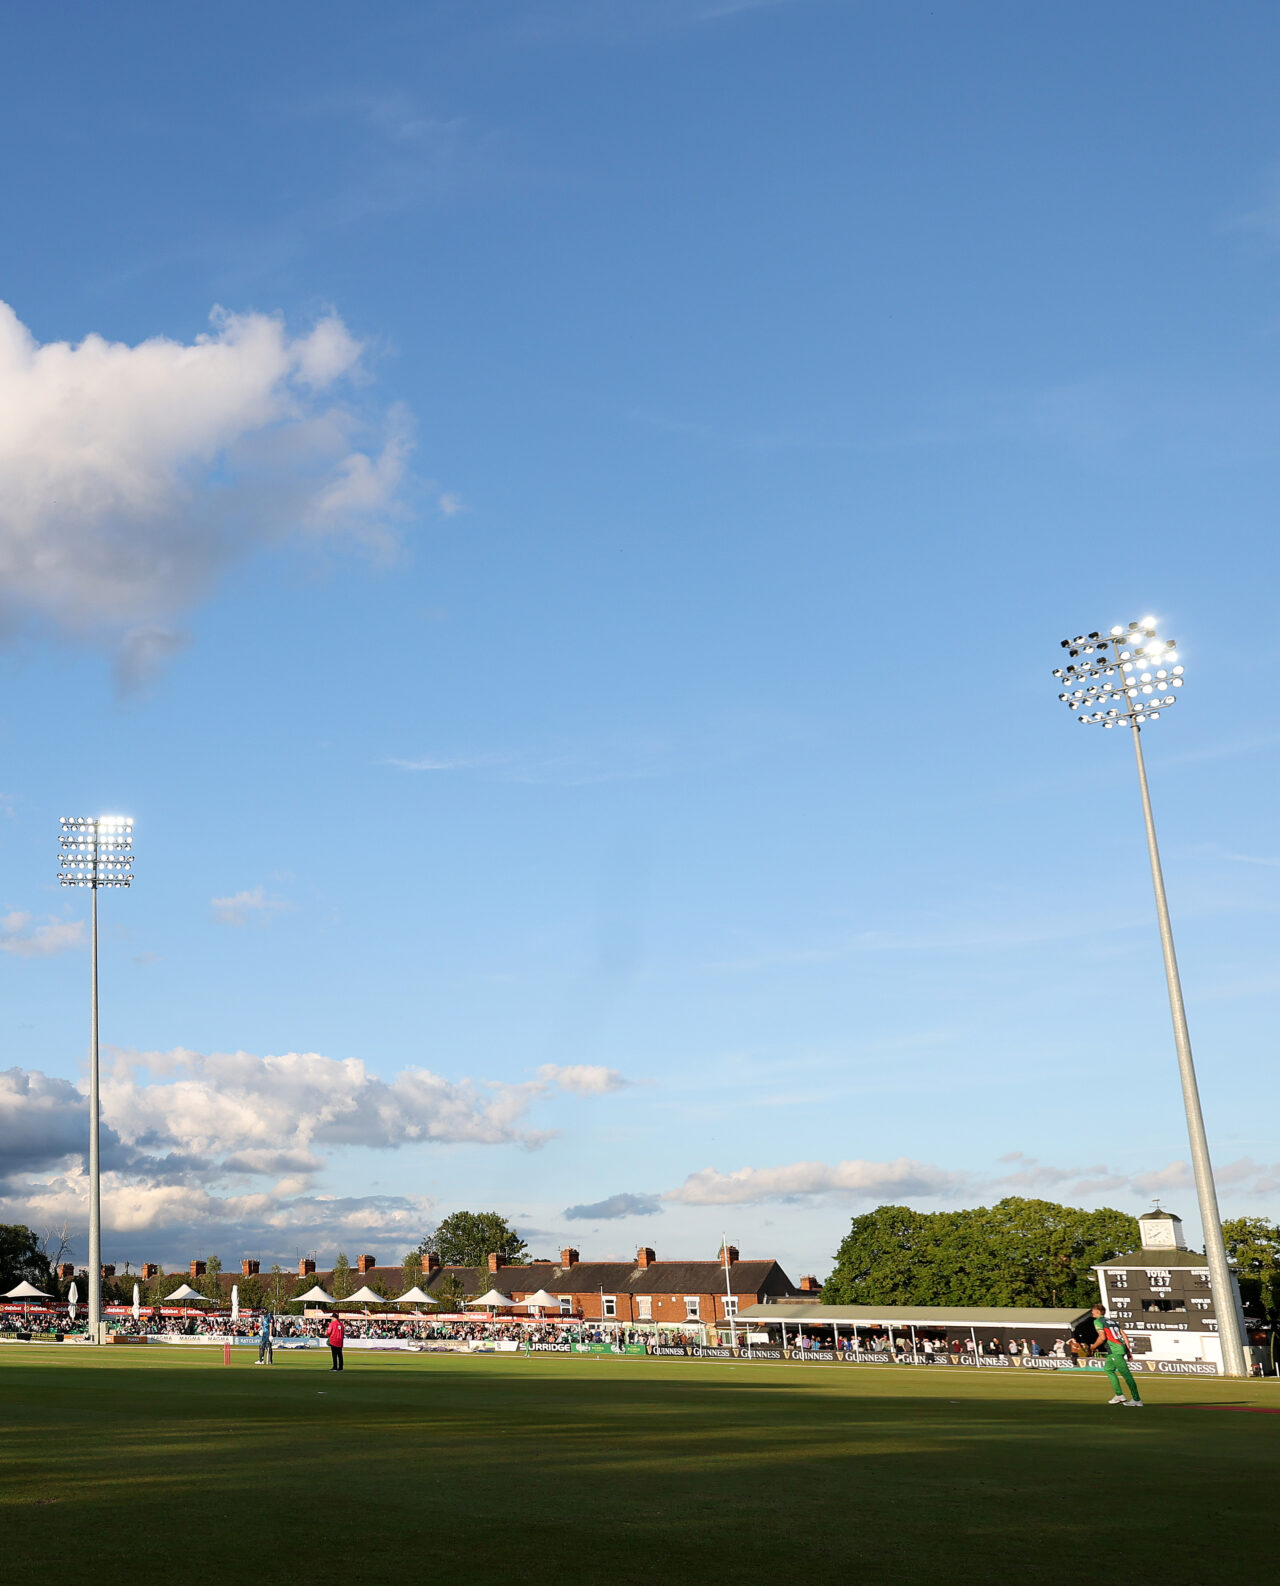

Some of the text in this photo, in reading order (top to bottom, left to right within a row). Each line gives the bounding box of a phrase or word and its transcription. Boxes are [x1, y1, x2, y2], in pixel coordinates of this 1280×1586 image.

[1146, 1270, 1172, 1278] TOTAL
[1151, 1277, 1170, 1286] 137
[519, 1343, 571, 1352] SURRIDGE
[653, 1346, 685, 1356] GUINNESS
[693, 1347, 730, 1357] GUINNESS
[740, 1349, 780, 1359] GUINNESS
[792, 1350, 833, 1361] GUINNESS
[845, 1352, 889, 1362] GUINNESS
[902, 1353, 947, 1364] GUINSS
[960, 1355, 1009, 1366] GUNNESS
[1022, 1357, 1074, 1369] GUINNESS
[1158, 1361, 1216, 1374] GUINNESS
